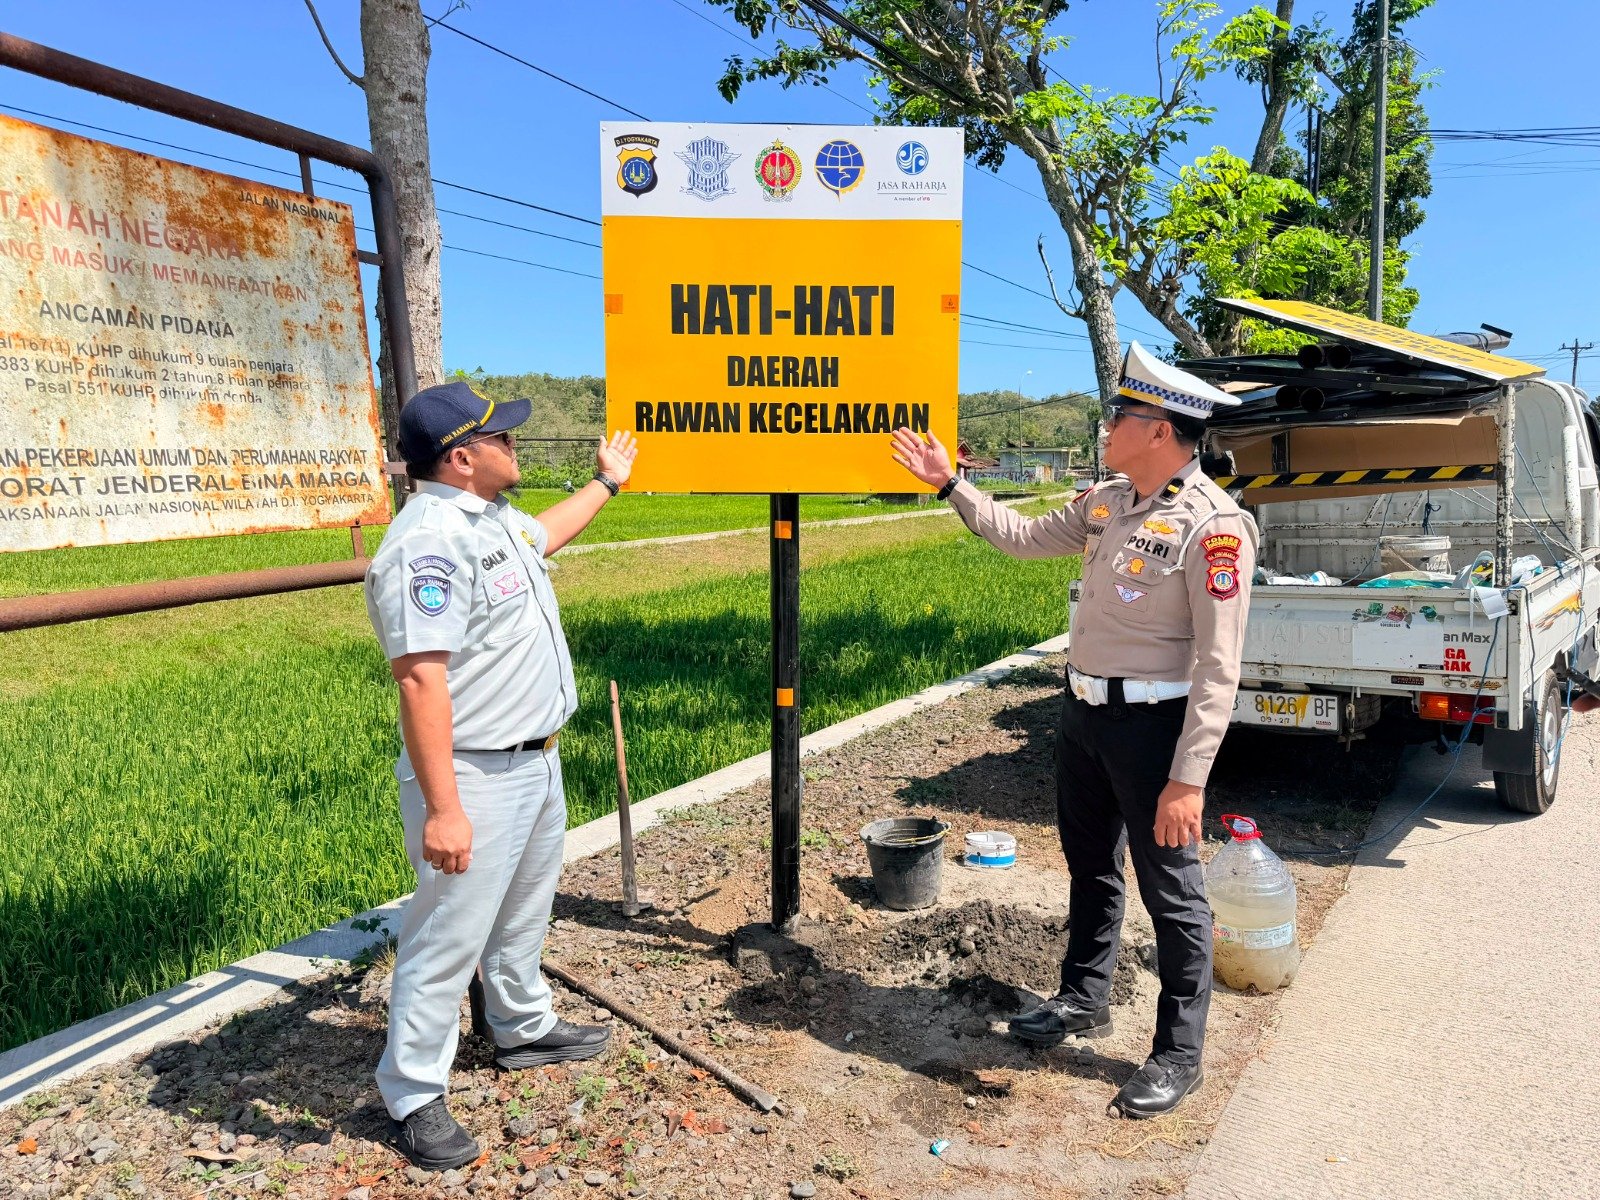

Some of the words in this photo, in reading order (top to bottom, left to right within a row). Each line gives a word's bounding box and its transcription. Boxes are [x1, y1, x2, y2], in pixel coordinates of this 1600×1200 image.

[877, 182, 899, 191] JASA
[901, 182, 947, 191] RAHARJA
[238, 190, 278, 210] JALAN
[282, 202, 342, 224] NASIONAL
[0, 190, 110, 238] TANAH
[120, 212, 244, 262] NEGARA
[52, 245, 134, 276] MASUK
[152, 263, 308, 302] MEMANFAATKAN
[40, 300, 154, 330] ANCAMAN
[160, 314, 234, 338] PIDANA
[670, 284, 894, 335] HATI-HATI
[76, 342, 122, 358] KUHP
[128, 348, 192, 365] dihukum
[196, 352, 204, 365] 9
[208, 354, 246, 369] bulan
[250, 360, 294, 374] penjara
[728, 356, 839, 388] DAERAH
[25, 378, 72, 394] Pasal
[77, 381, 104, 396] 551
[110, 383, 154, 398] KUHP
[36, 359, 84, 376] KUHP
[90, 364, 156, 381] dihukum
[162, 369, 170, 382] 2
[174, 370, 213, 385] tahun
[218, 372, 224, 385] 8
[268, 378, 310, 392] penjara
[635, 401, 740, 432] RAWAN
[748, 403, 929, 434] KECELAKAAN
[26, 448, 138, 468] PEKERJAAN
[141, 448, 192, 467] UMUM
[196, 449, 228, 466] DAN
[320, 450, 368, 465] RAKYAT
[0, 477, 86, 498] ORAT
[97, 474, 234, 496] JENDERAL
[300, 472, 372, 488] MARGA
[96, 502, 144, 517] JALAN
[148, 500, 218, 514] NASIONAL
[302, 494, 374, 506] YOGYAKARTA
[1126, 535, 1170, 558] POLRI
[1462, 632, 1490, 643] Max
[1255, 694, 1297, 715] 8126
[1314, 698, 1336, 717] BF
